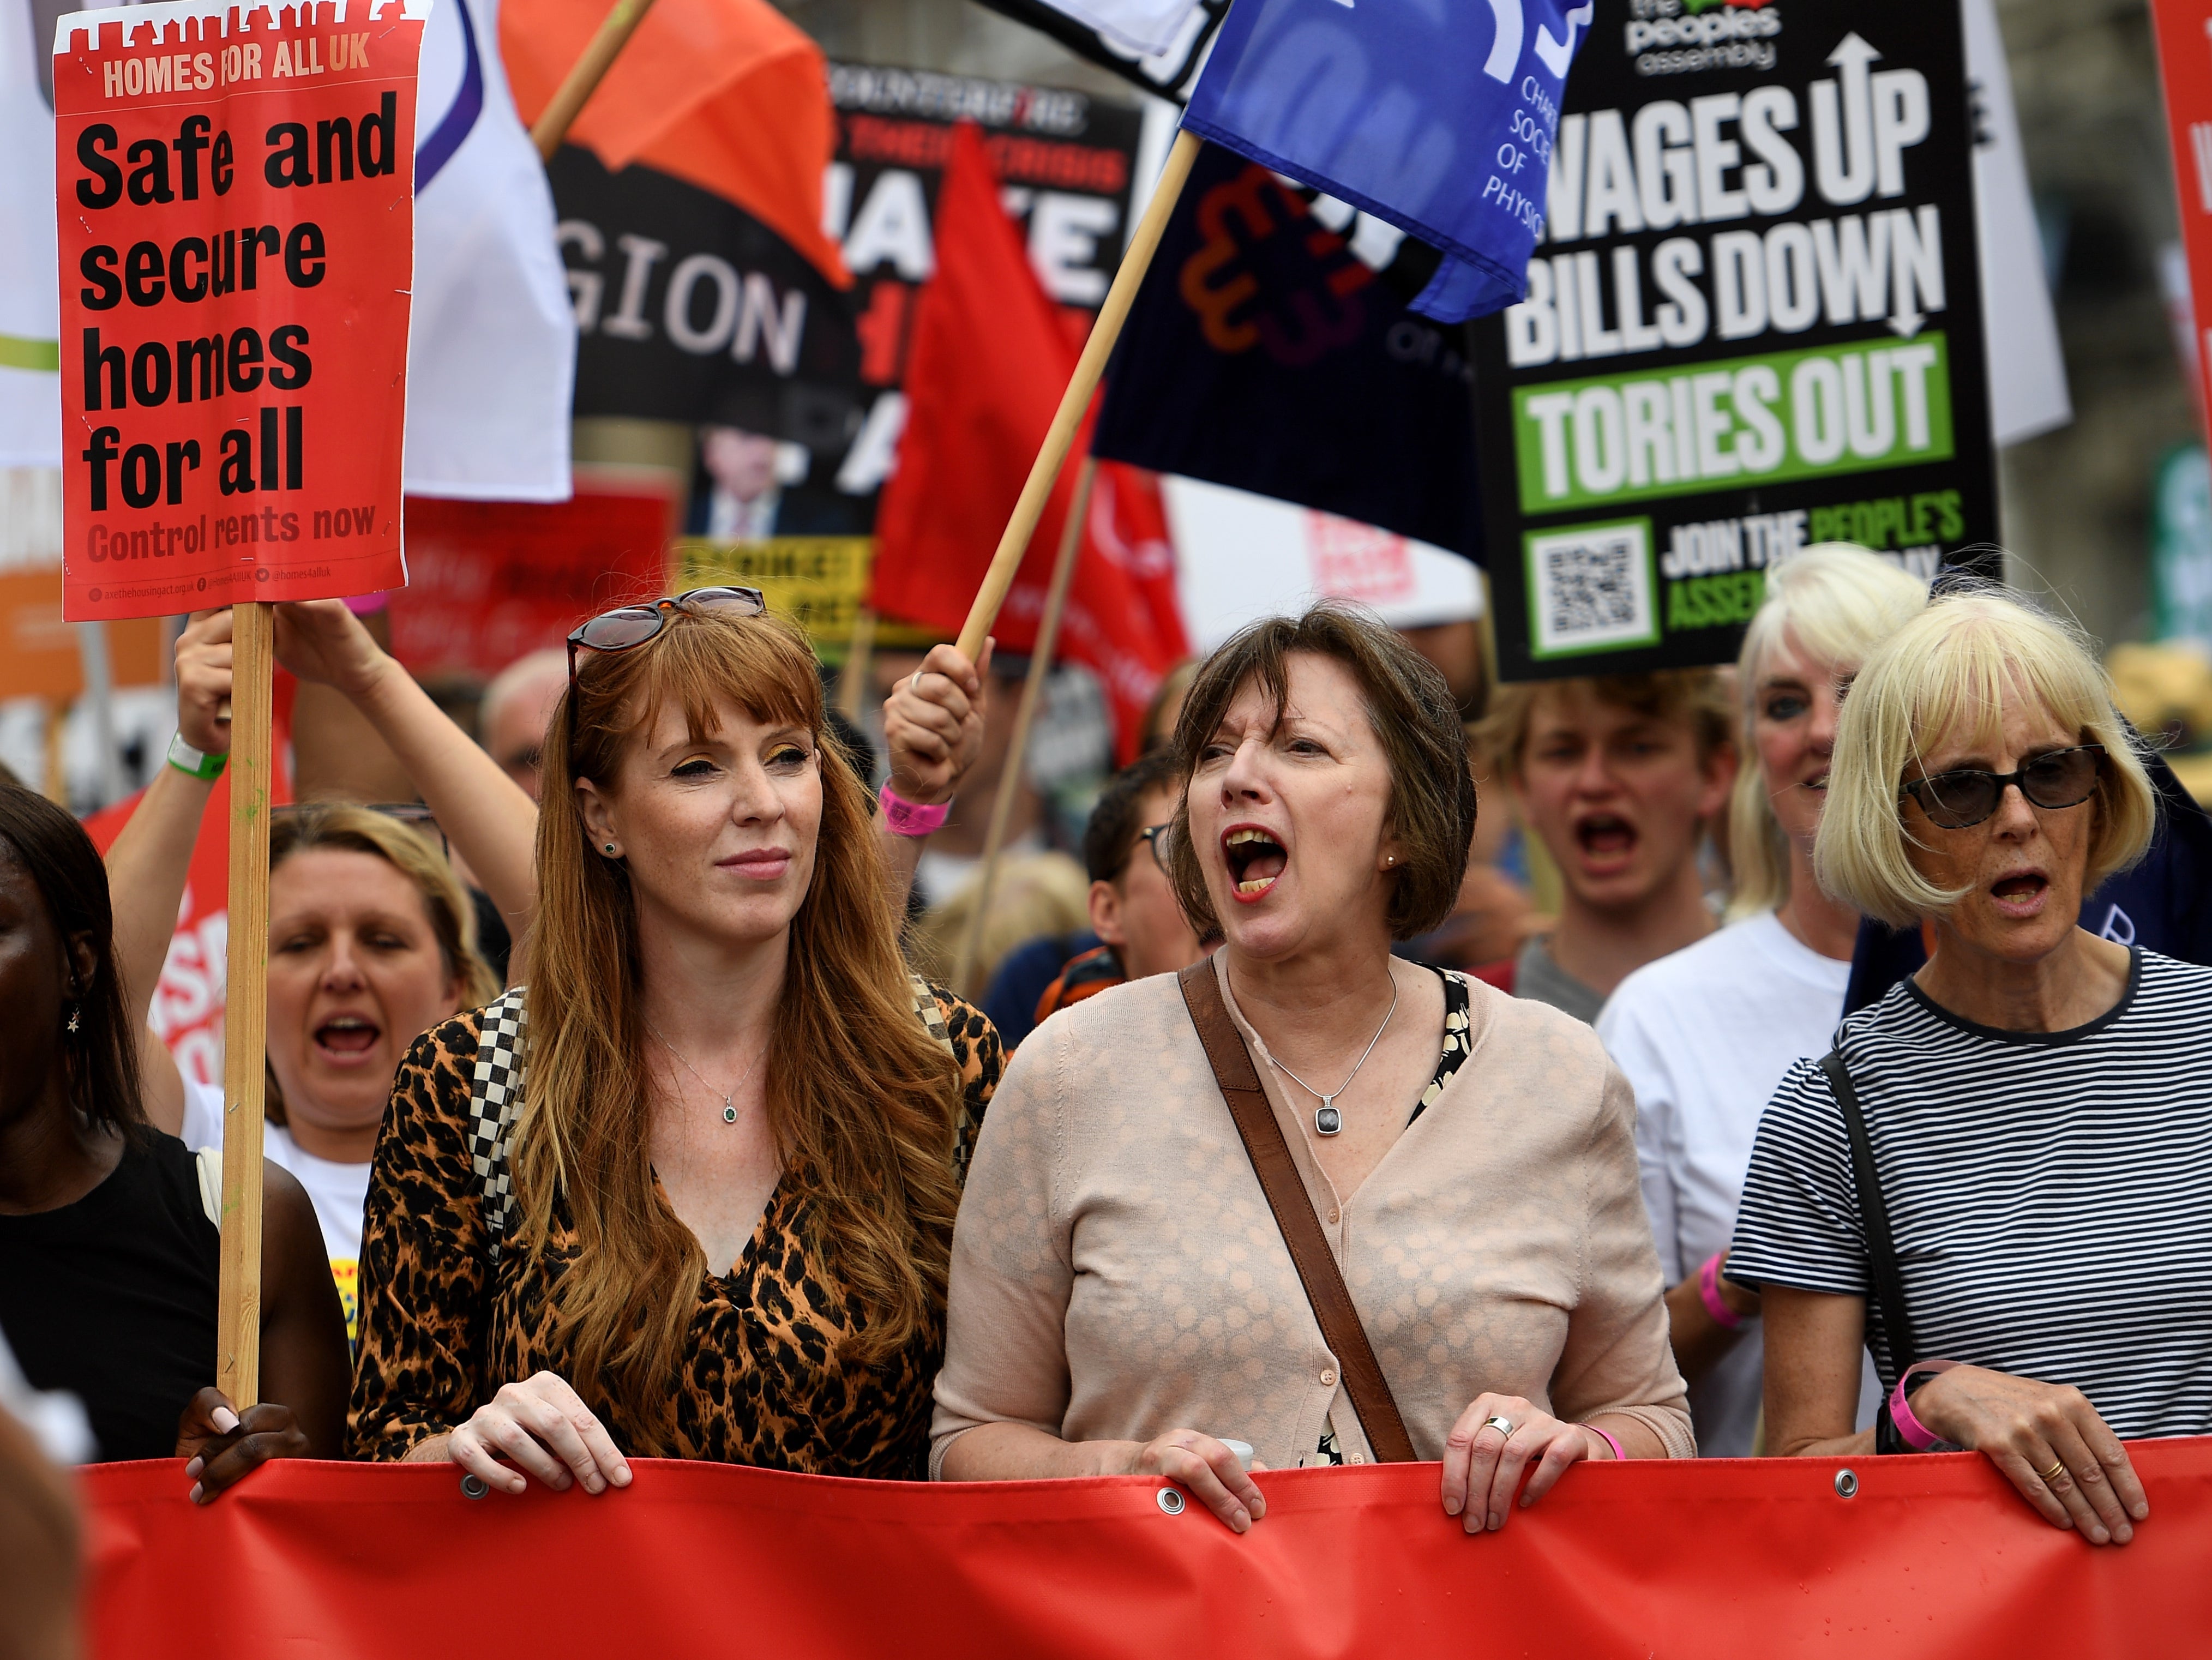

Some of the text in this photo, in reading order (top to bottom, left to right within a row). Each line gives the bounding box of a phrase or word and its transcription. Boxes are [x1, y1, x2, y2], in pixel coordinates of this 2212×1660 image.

[103, 33, 370, 99] HOMES FOR ALL UK
[1625, 5, 1782, 54] peoples
[1636, 41, 1776, 76] assembly
[75, 91, 397, 210] Safe and
[1496, 142, 1528, 175] OF
[1808, 55, 1931, 206] UP
[79, 221, 326, 312] secure
[1505, 204, 1946, 369] BILLS DOWN
[83, 324, 312, 412] homes
[82, 406, 304, 512] for all
[1529, 344, 1937, 498] TORIES OUT
[87, 515, 207, 563] Control
[215, 506, 300, 550] rents
[313, 506, 376, 540] now
[1662, 490, 1964, 579] JOIN THE PEOPLE'S
[104, 582, 195, 600] axethehousingact.org.uk
[273, 567, 332, 581] @homes4alluk
